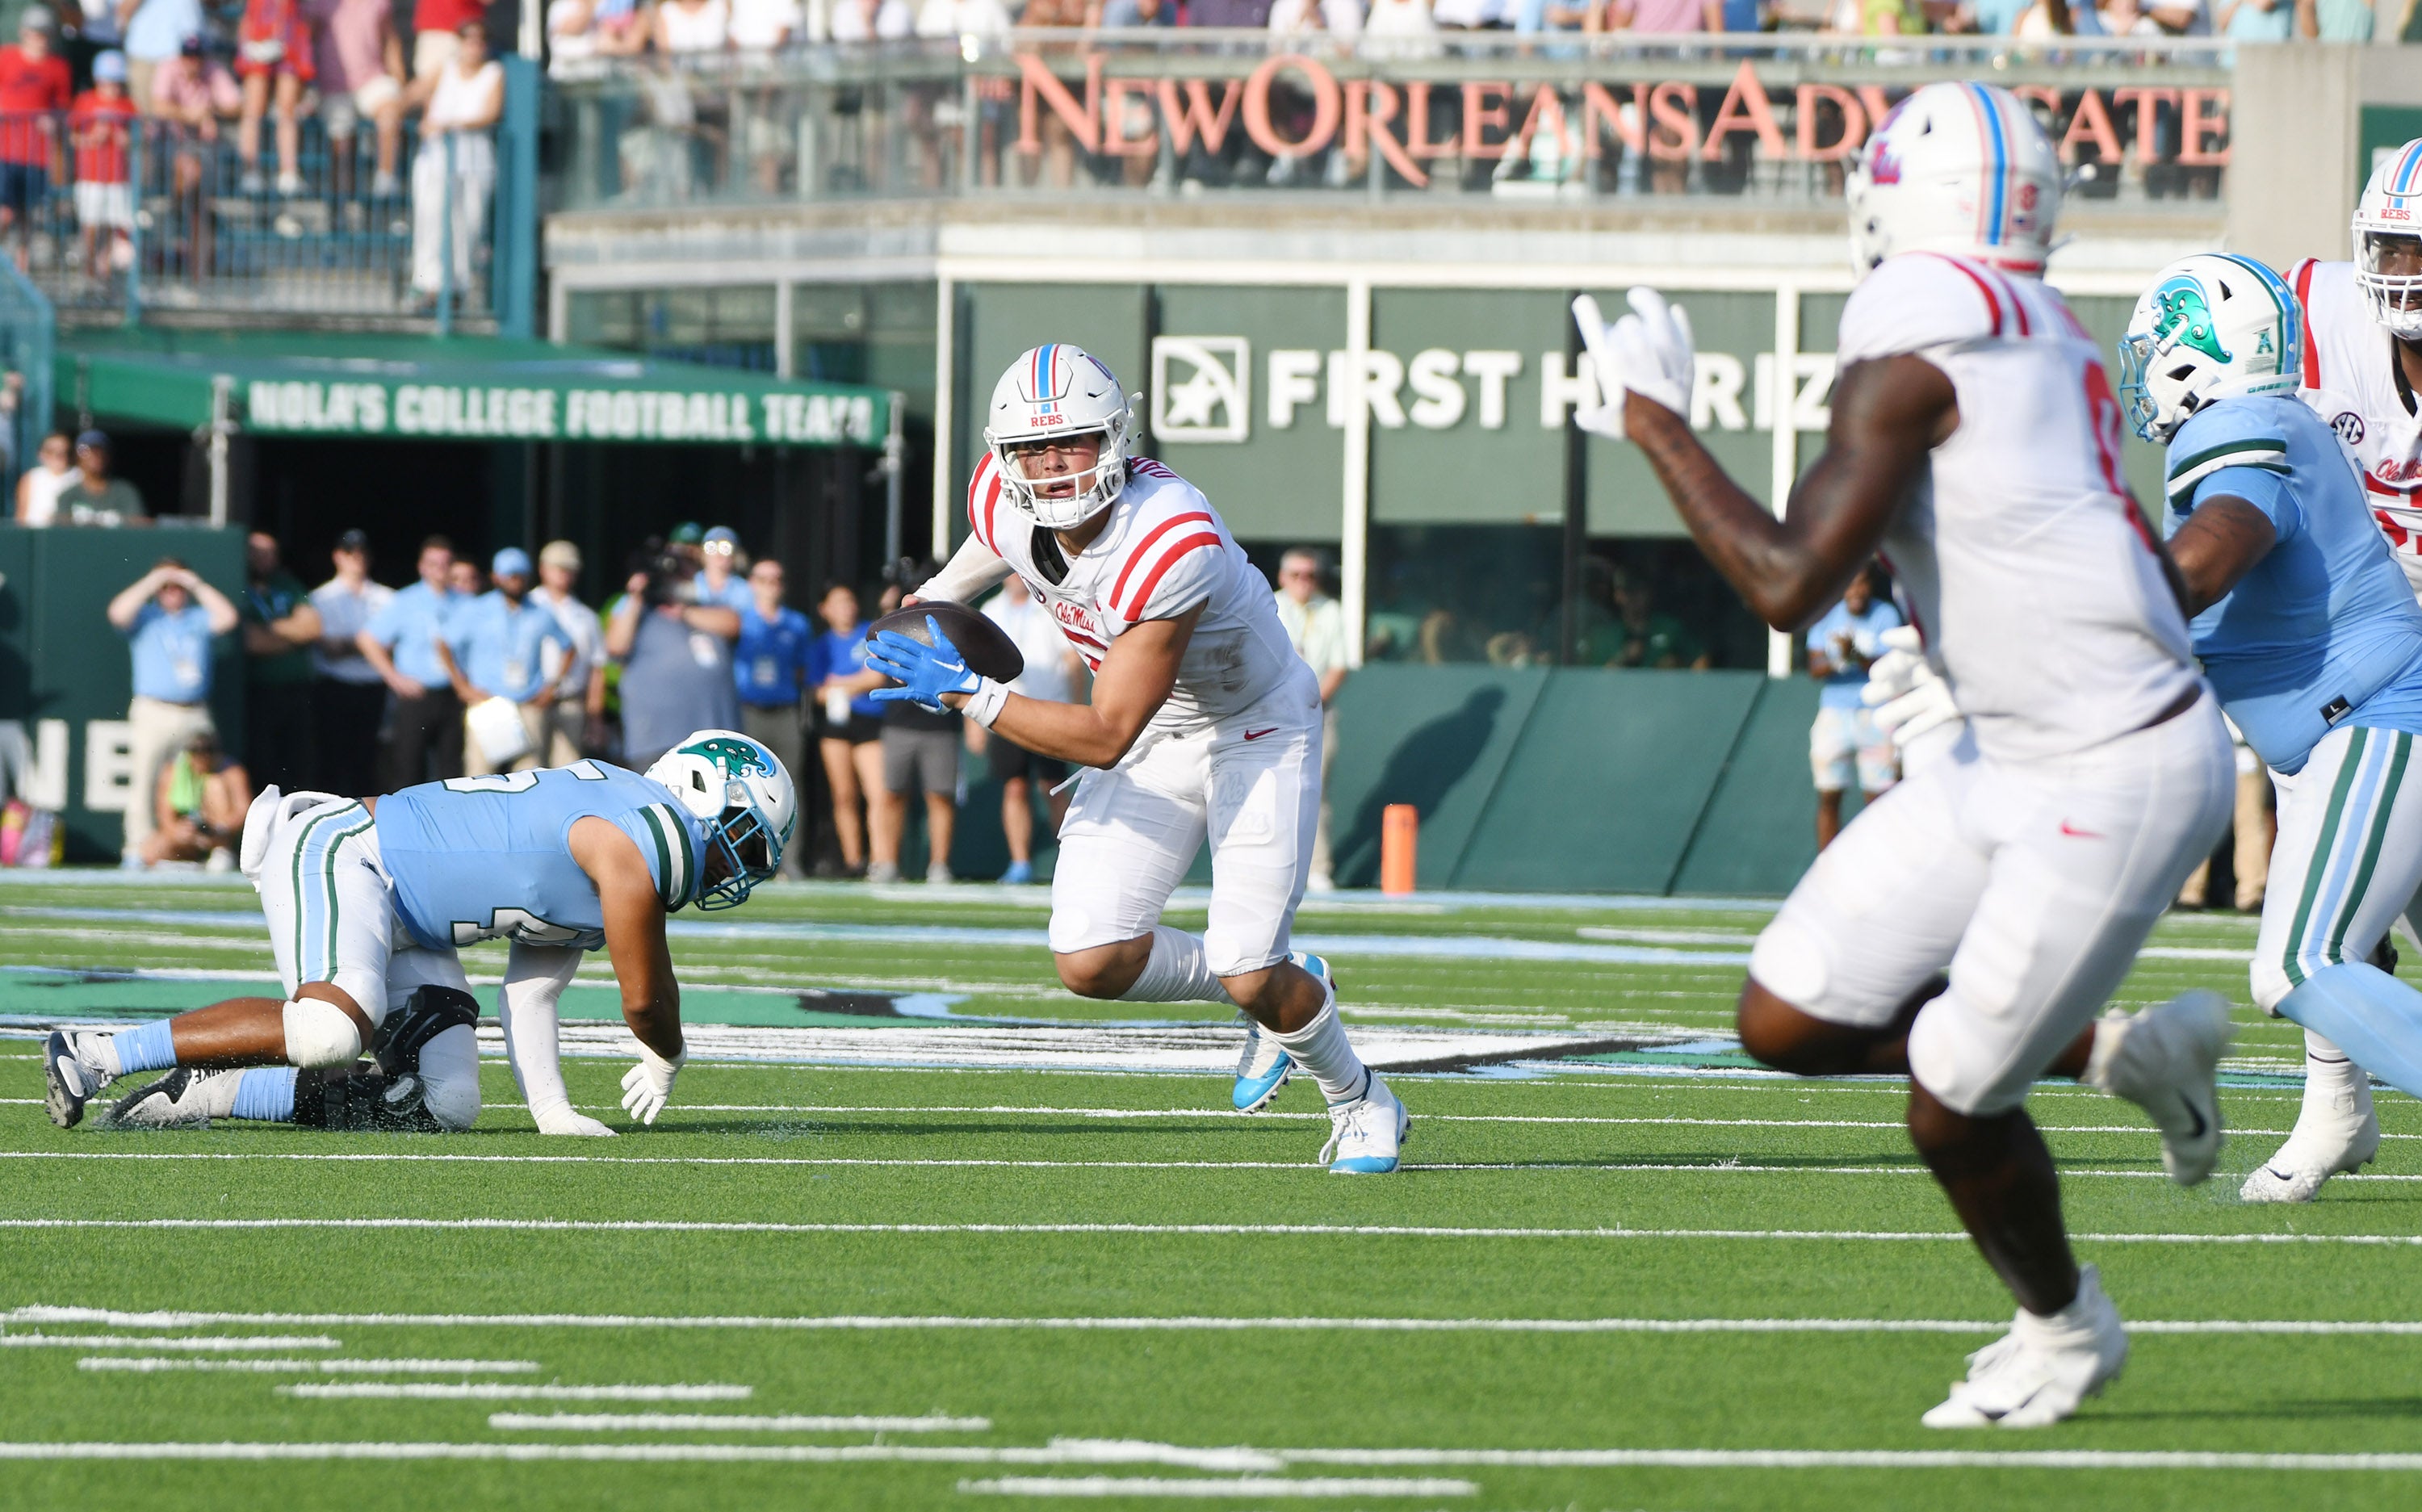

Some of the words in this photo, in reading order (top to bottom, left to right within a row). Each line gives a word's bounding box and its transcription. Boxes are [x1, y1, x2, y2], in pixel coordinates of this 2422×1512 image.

[1701, 58, 2231, 166] ADATE
[2381, 209, 2411, 220] REBS
[1268, 348, 1523, 429] FIRST
[1540, 350, 1837, 430] HRIZ
[249, 380, 388, 433] NOLA'S
[396, 384, 558, 437] COLLEGE
[568, 389, 755, 440] FOOTBALL
[1031, 414, 1064, 427] REBS
[2331, 413, 2362, 442] SEC
[2376, 459, 2400, 481] Ole
[1056, 602, 1072, 626] Ole
[1071, 606, 1096, 633] Miss
